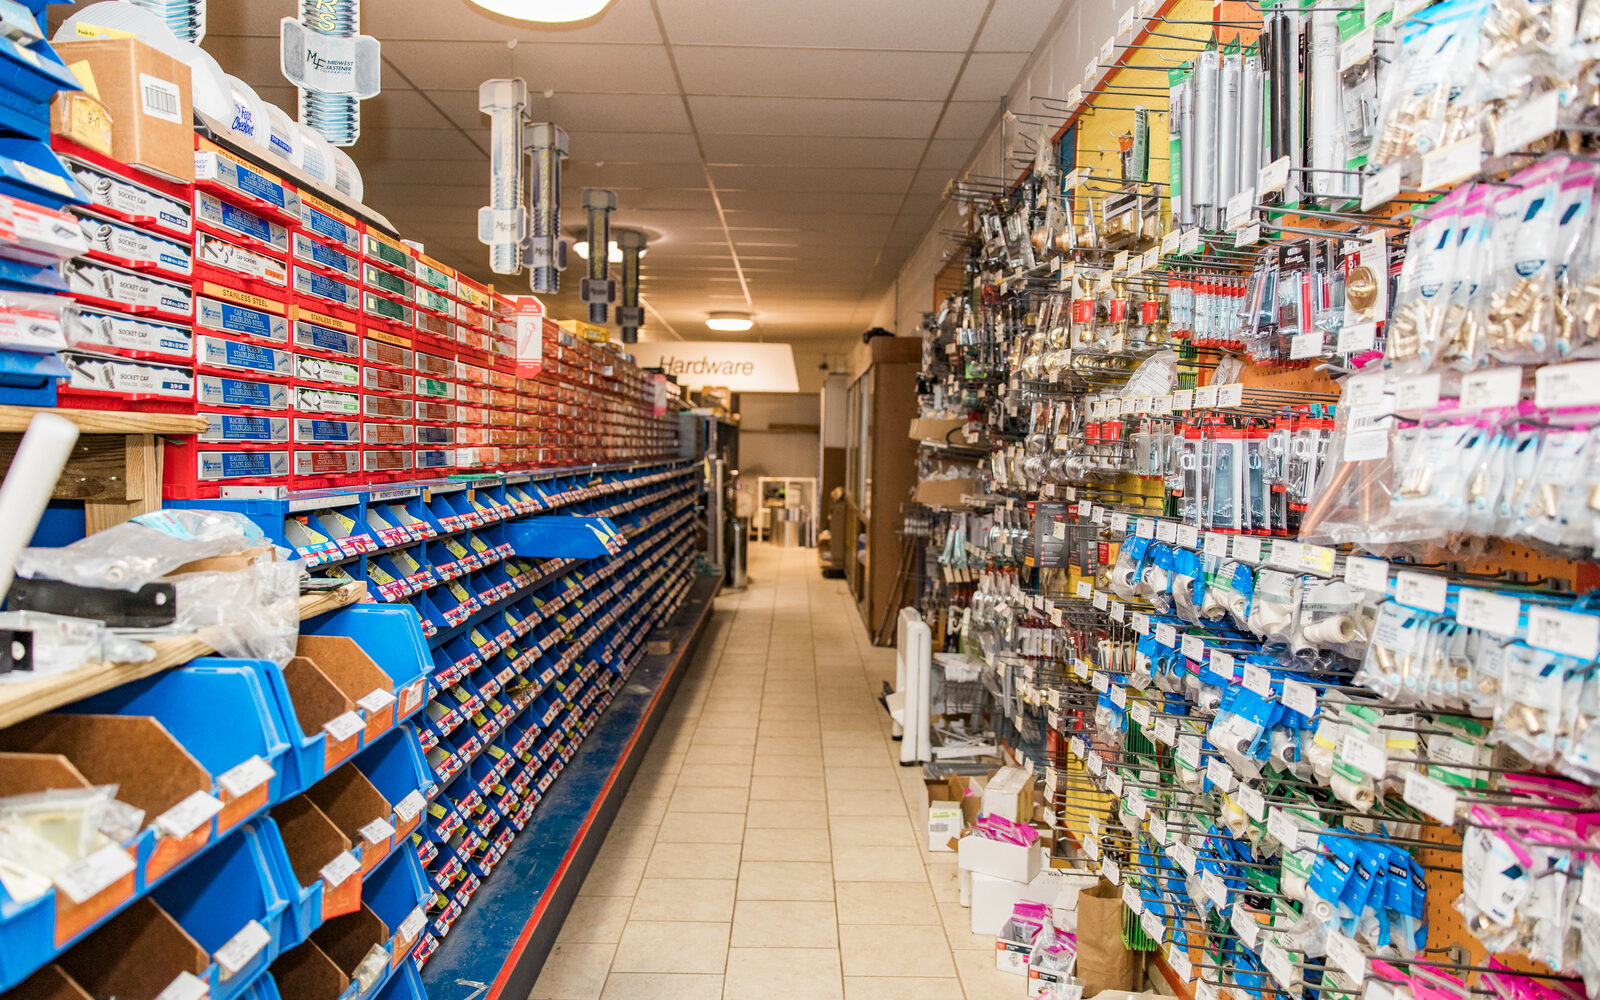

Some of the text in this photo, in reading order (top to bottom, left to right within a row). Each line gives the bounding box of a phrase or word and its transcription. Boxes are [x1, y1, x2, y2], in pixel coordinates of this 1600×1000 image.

[118, 191, 137, 202] SOCKET
[118, 237, 137, 248] SOCKET
[119, 281, 149, 293] SOCKET CAP
[222, 289, 268, 307] STAINLESS STEEL
[118, 329, 137, 337] SOCKET
[660, 355, 754, 376] Hardware
[120, 373, 139, 381] SOCKET
